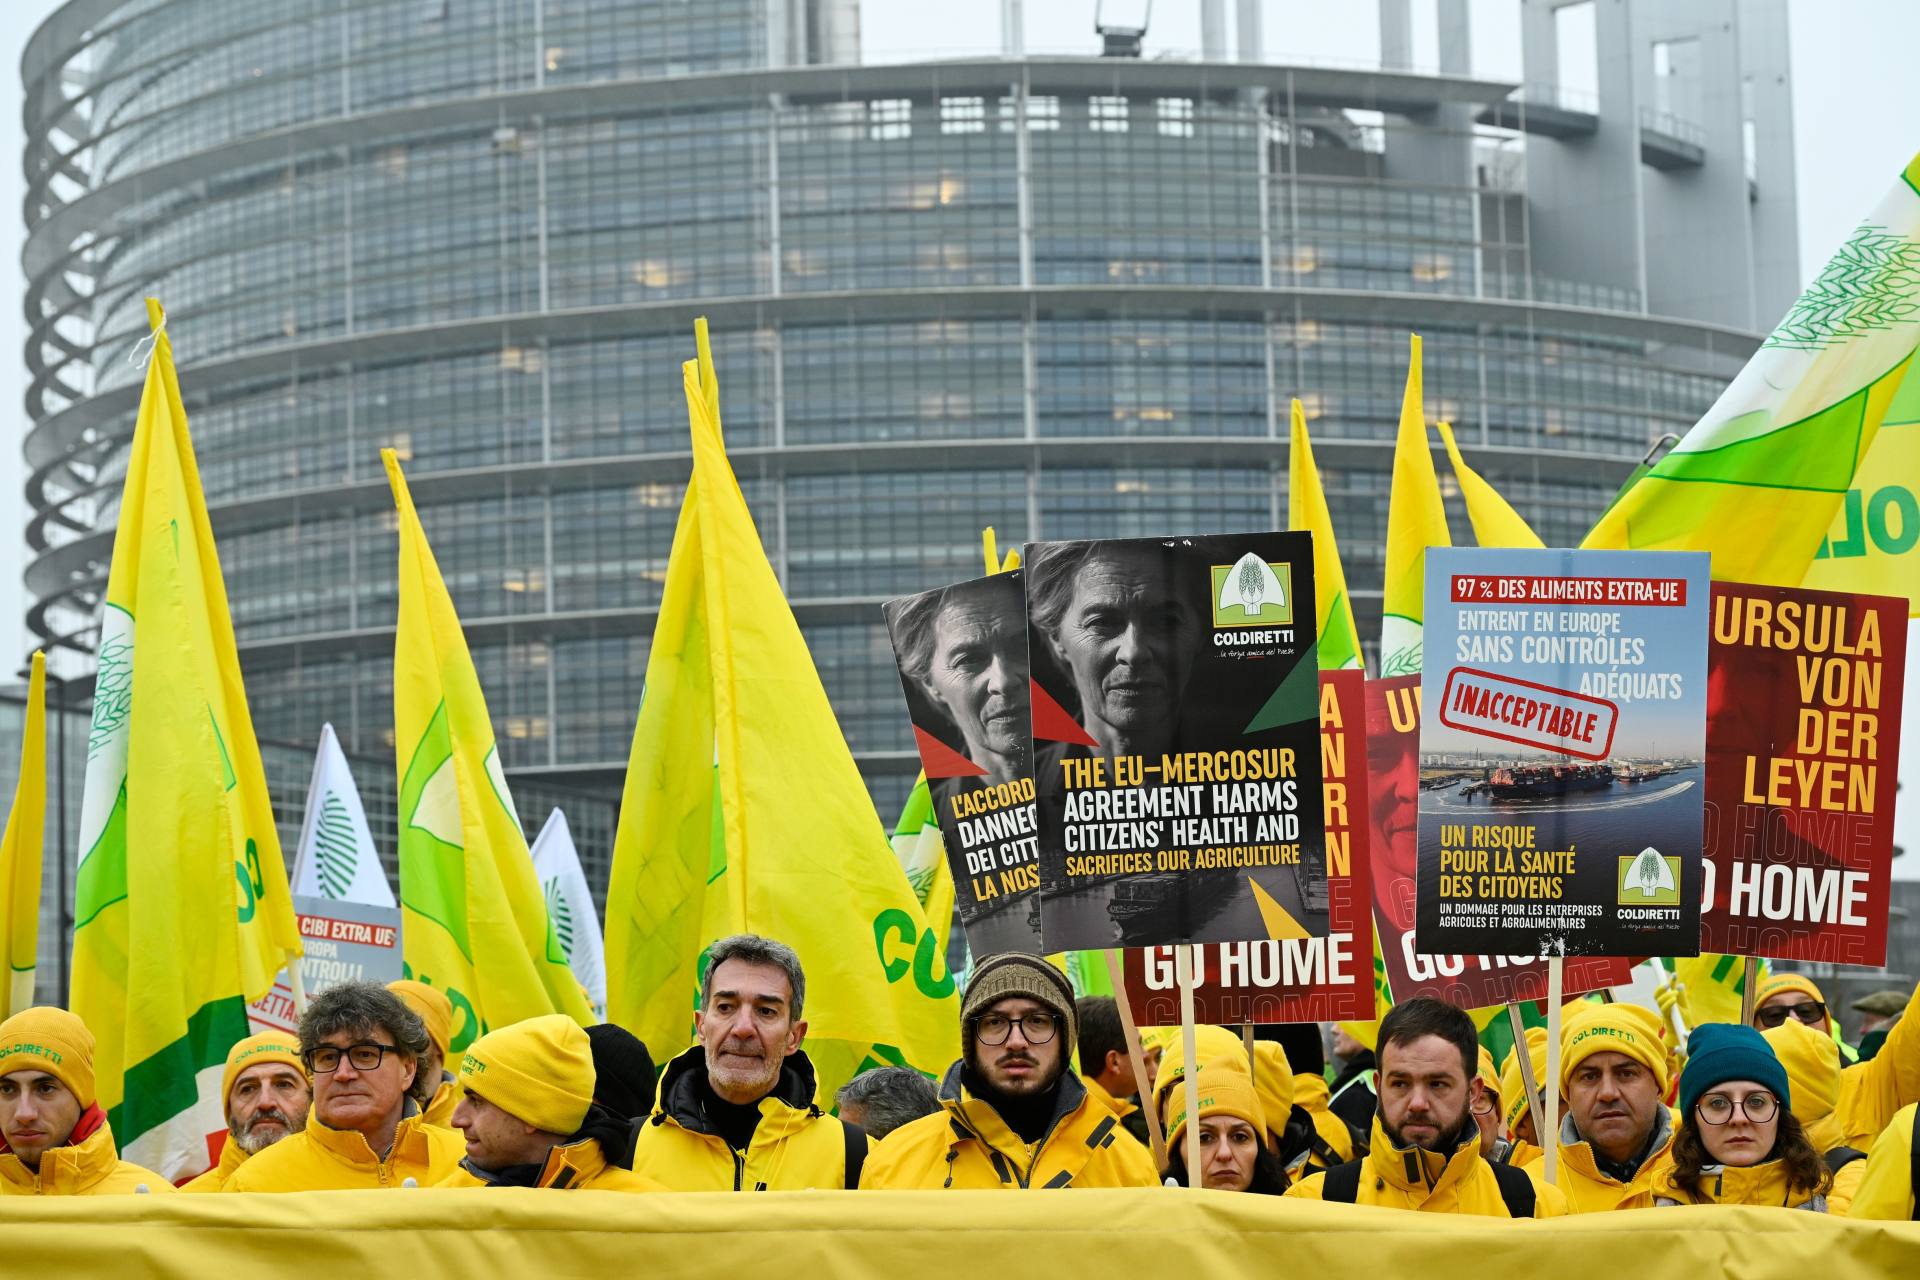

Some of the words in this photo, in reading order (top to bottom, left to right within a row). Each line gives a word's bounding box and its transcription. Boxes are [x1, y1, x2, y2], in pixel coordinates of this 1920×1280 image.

[1457, 578, 1476, 598] 97
[1480, 581, 1493, 598] %
[1498, 579, 1526, 599] DES
[1530, 580, 1603, 600] ALIMENTS
[1608, 581, 1678, 602] EXTRA-UE
[1213, 630, 1294, 646] COLDIRETTI
[1458, 610, 1529, 632] ENTRENT
[1533, 611, 1554, 632] EN
[1559, 612, 1621, 633] EUROPE
[1713, 595, 1882, 657] URSULA
[1456, 635, 1514, 663] SANS
[1521, 631, 1645, 666] CONTRÔLES
[1579, 665, 1683, 703] ADÉQUATS
[1796, 655, 1883, 710] VON
[1385, 686, 1421, 733] U
[1453, 682, 1598, 744] INACCEPTABLE
[1796, 708, 1878, 760] DER
[1060, 757, 1106, 789] THE
[1114, 748, 1297, 786] EU-MERCOSUR
[1743, 755, 1877, 814] LEYEN
[951, 777, 1036, 819] L'ACCORD
[1063, 785, 1204, 822] AGREEMENT
[1212, 780, 1298, 814] HARMS
[1064, 820, 1164, 852] CITIZENS'
[1172, 816, 1248, 846] HEALTH
[1255, 813, 1299, 842] AND
[1441, 825, 1466, 848] UN
[1472, 825, 1536, 850] RISQUE
[1734, 805, 1873, 870] HOME
[965, 847, 997, 875] DEI
[1066, 852, 1152, 876] SACRIFICES
[1157, 850, 1190, 871] OUR
[1195, 844, 1300, 869] AGRICULTURE
[1440, 850, 1489, 873] POUR
[1494, 851, 1515, 874] LA
[1521, 845, 1576, 874] SANTÉ
[972, 875, 999, 902] LA
[1000, 863, 1040, 895] NOS
[1439, 875, 1473, 898] DES
[1478, 875, 1563, 899] CITOYENS
[1730, 861, 1870, 927] HOME
[1439, 916, 1486, 928] AGRICOLES
[1489, 917, 1500, 928] ET
[1501, 917, 1586, 929] AGROALIMENTAIRES
[1440, 904, 1452, 914] UN
[1455, 904, 1499, 915] DOMMAGE
[1501, 904, 1525, 916] POUR
[1528, 905, 1543, 916] LES
[1545, 905, 1603, 917] ENTREPRISES
[1617, 909, 1680, 920] COLDIRETTI
[301, 917, 329, 937] CIBI
[331, 922, 372, 944] EXTRA
[375, 927, 391, 946] UE
[1144, 944, 1205, 991] GO
[1219, 933, 1355, 988] HOME
[1573, 1028, 1635, 1045] COLDIRETTI
